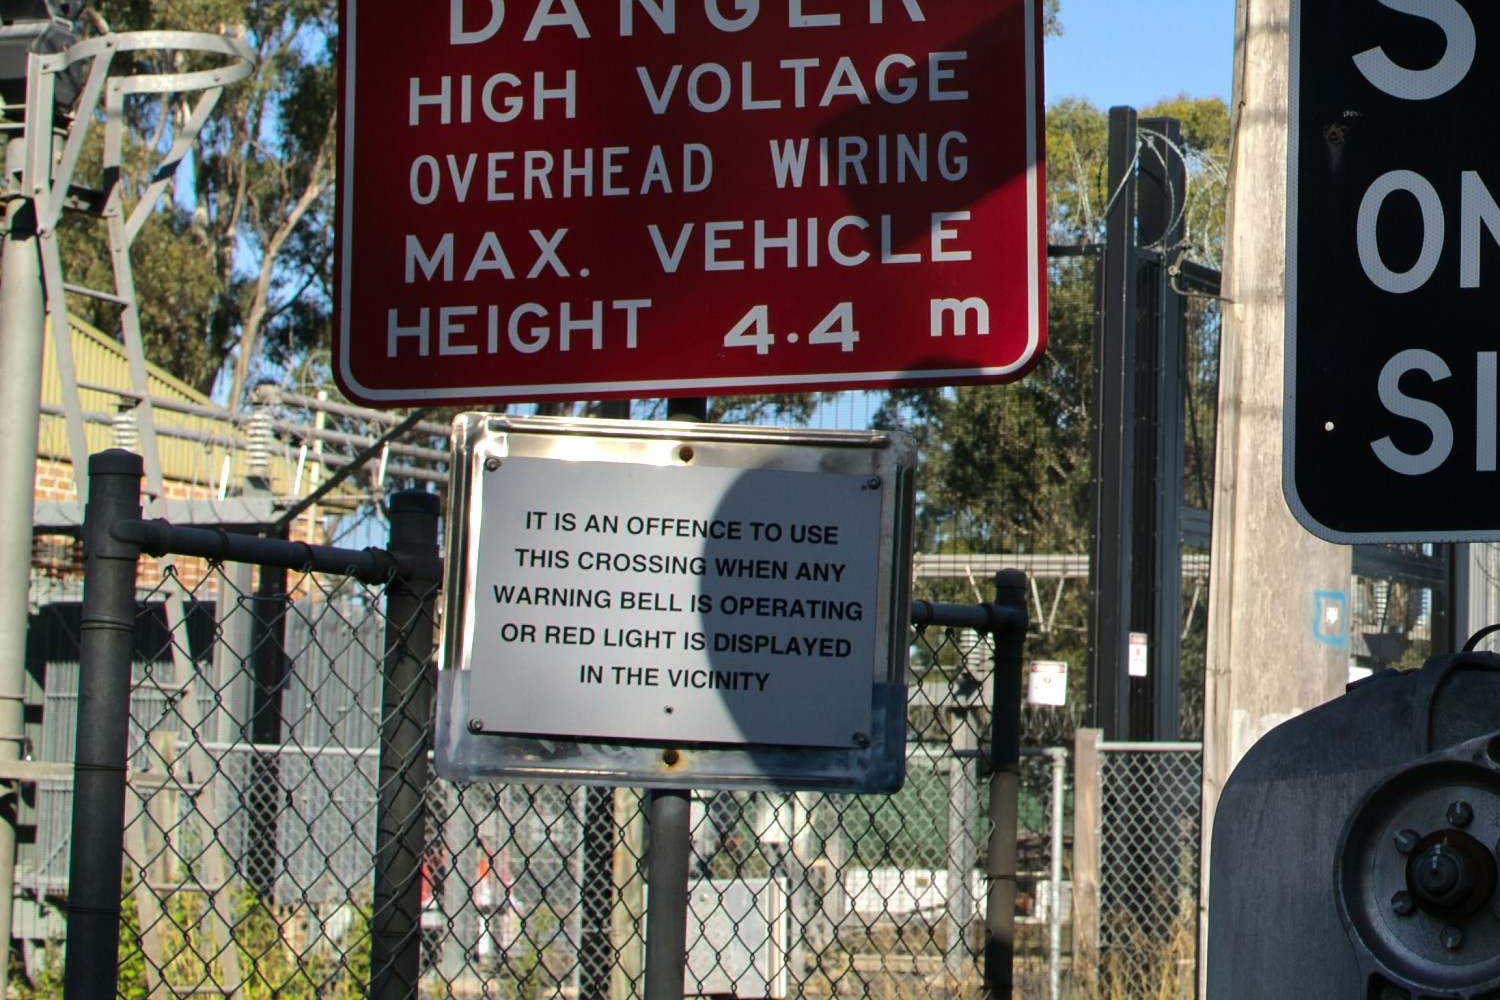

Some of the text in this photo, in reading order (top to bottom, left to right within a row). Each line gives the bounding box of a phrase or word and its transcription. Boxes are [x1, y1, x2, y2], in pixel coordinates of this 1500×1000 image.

[410, 52, 968, 125] HIGH VOLTAGE
[410, 132, 967, 204] OVERHEAD WIRING
[406, 211, 972, 282] MAX. VEHICLE
[388, 297, 989, 356] HEIGHT 4.4 m
[526, 511, 838, 544] IT IS AN OFFENCE TO USE
[515, 548, 845, 582] THIS CROSSING WHEN ANY
[493, 585, 862, 620] WARNING BELL IS OPERATING
[501, 623, 851, 657] OR RED LIGHT IS DISPLAYED
[580, 665, 769, 691] IN THE VICINITY
